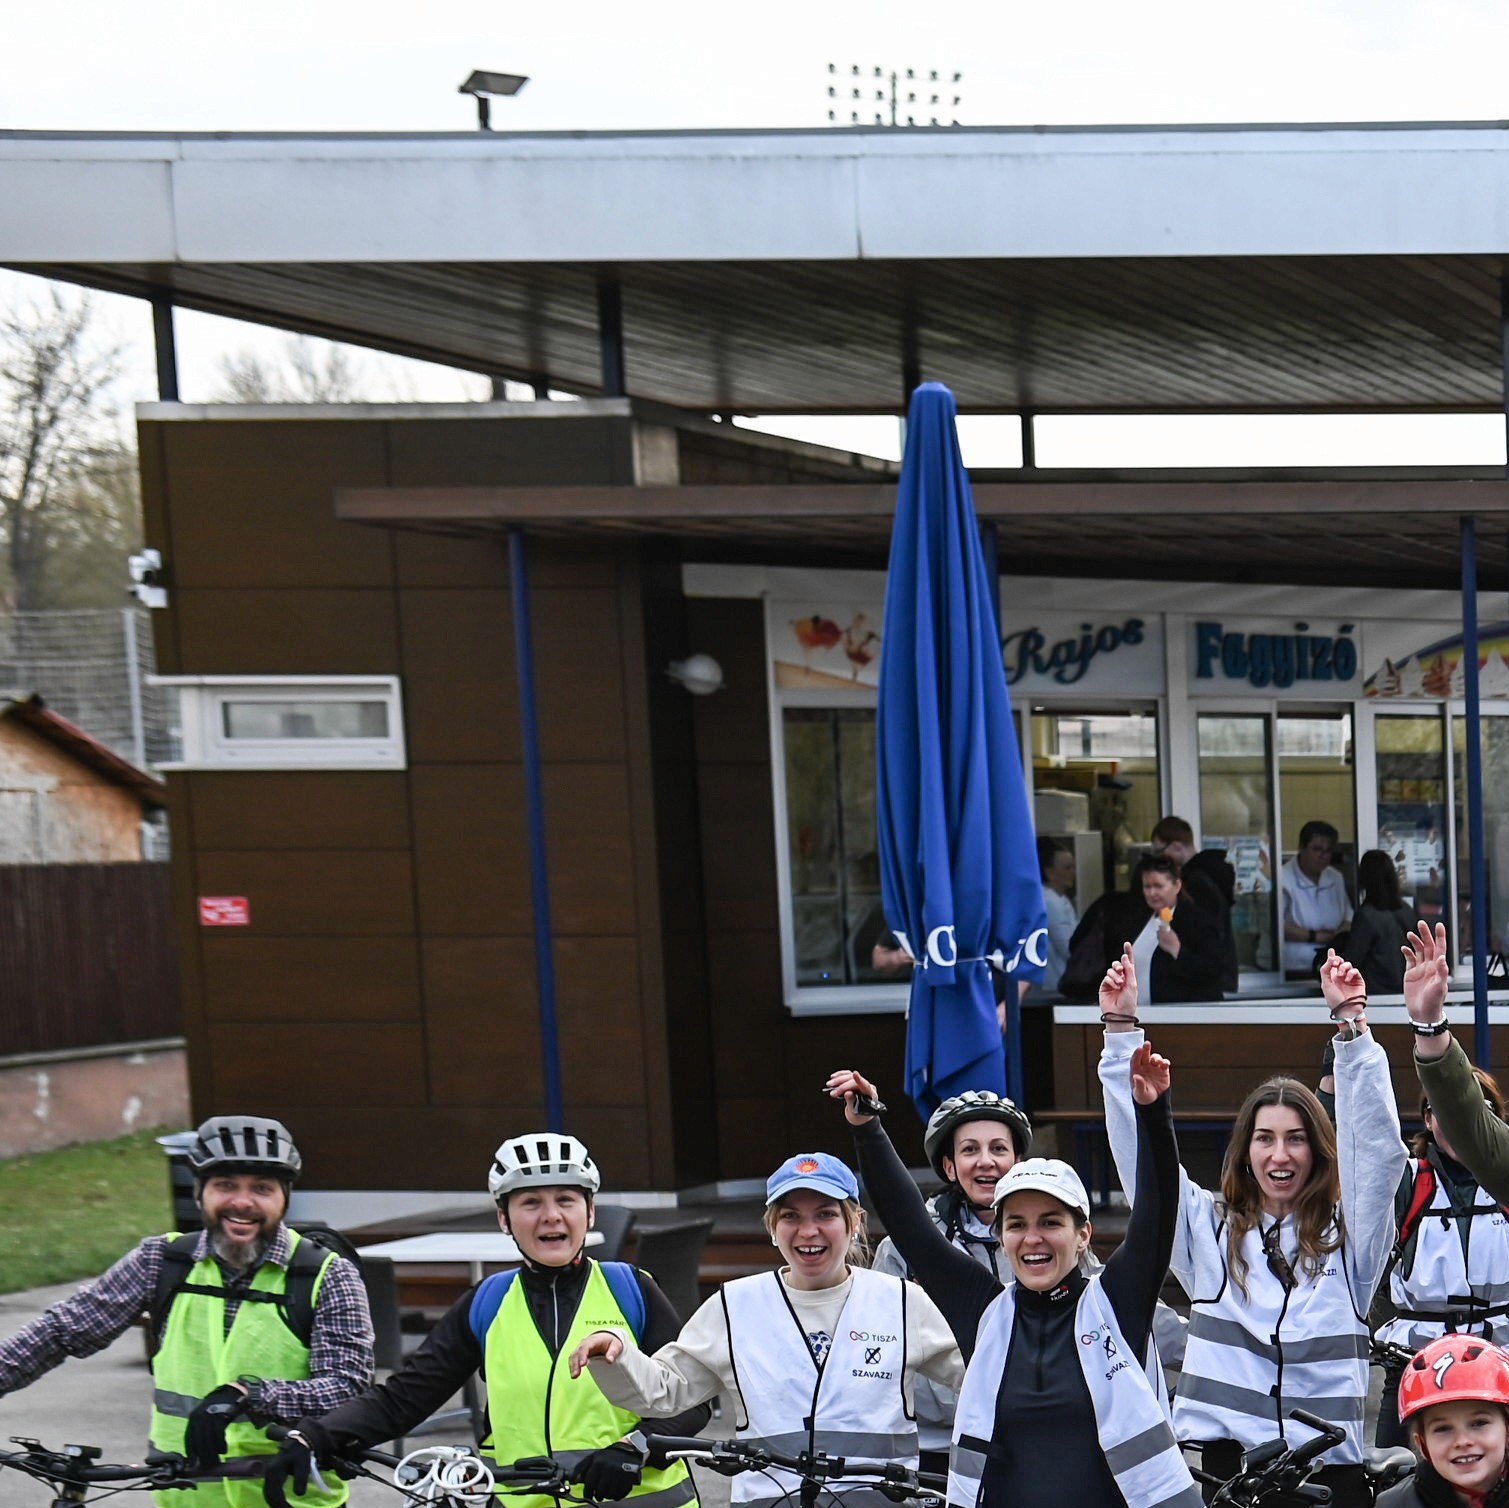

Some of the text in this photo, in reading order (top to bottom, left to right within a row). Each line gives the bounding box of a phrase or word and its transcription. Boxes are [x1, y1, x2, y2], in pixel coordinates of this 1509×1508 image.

[1195, 621, 1357, 689] Fagyizó
[872, 1333, 898, 1342] TISZA
[852, 1369, 893, 1380] SZAVAZZ!
